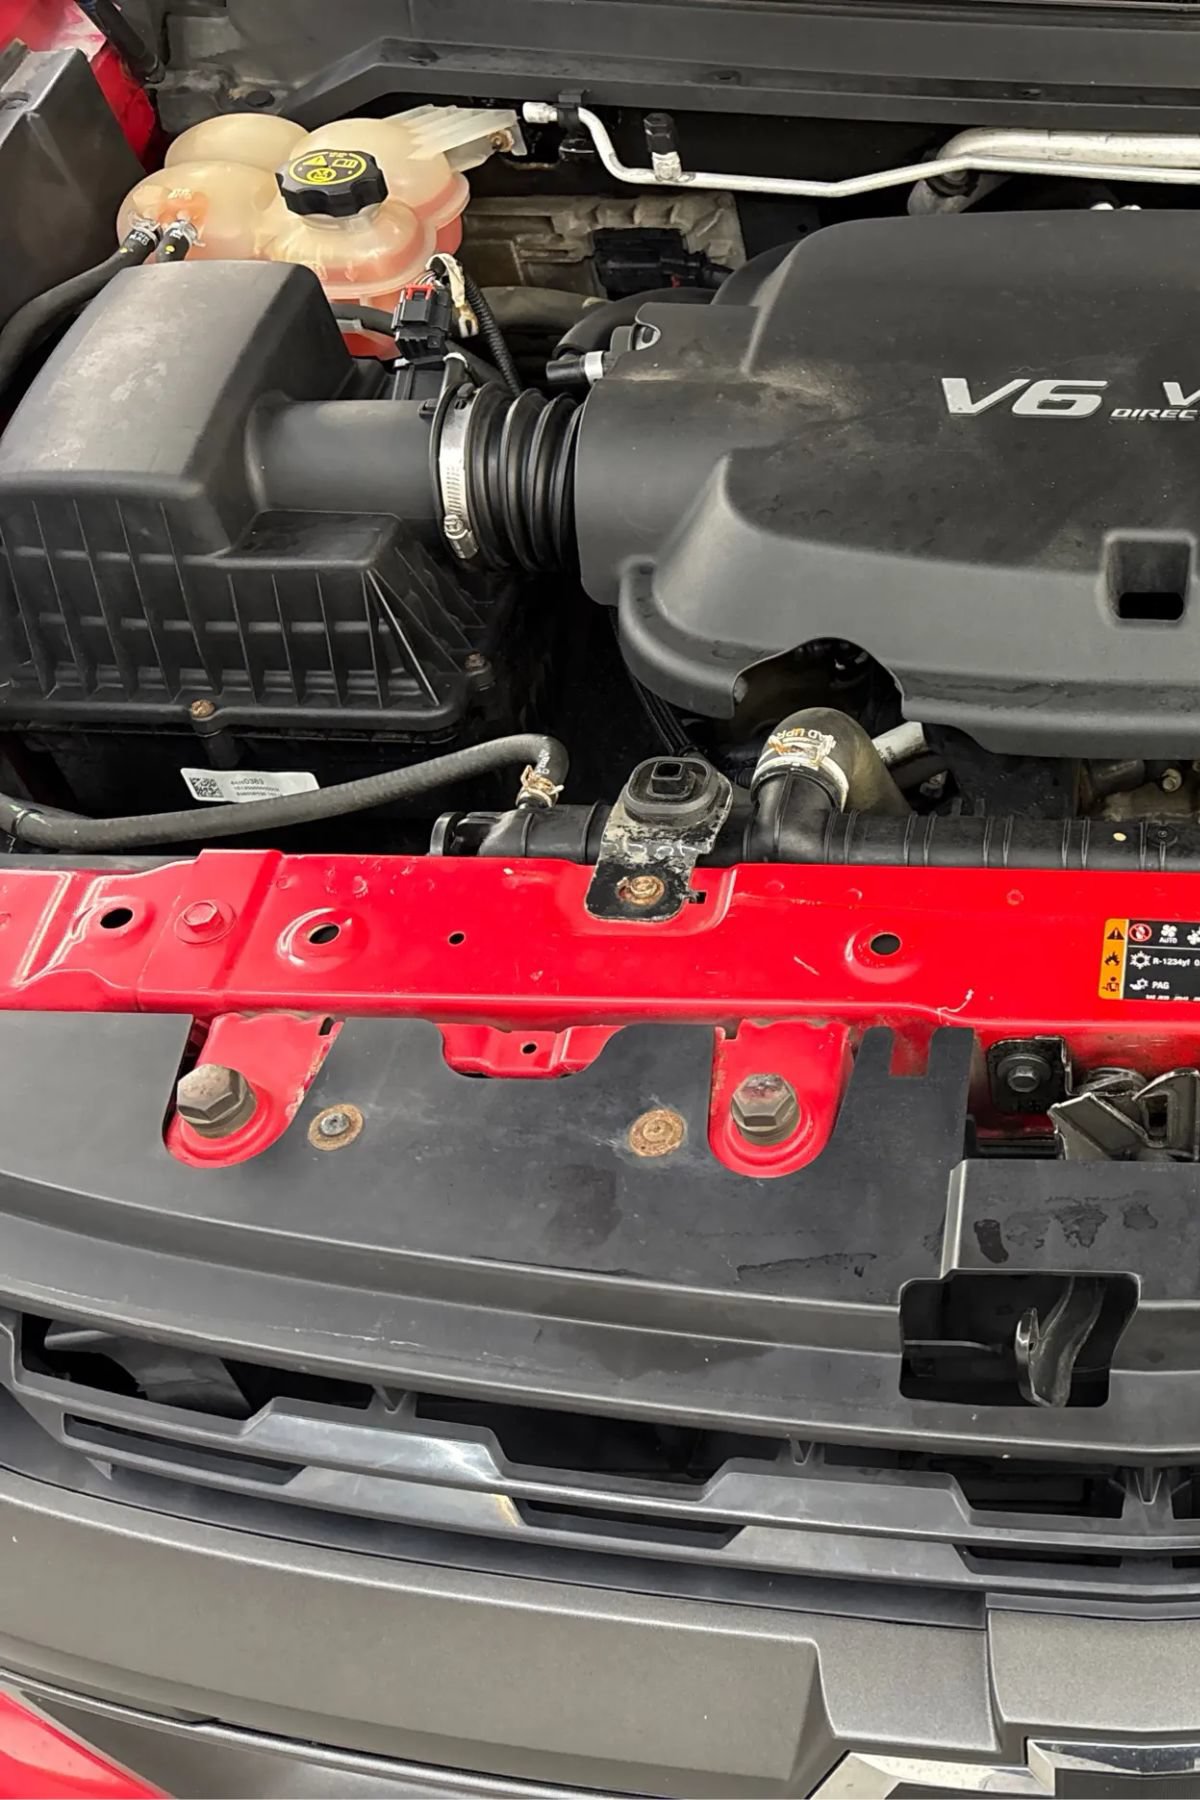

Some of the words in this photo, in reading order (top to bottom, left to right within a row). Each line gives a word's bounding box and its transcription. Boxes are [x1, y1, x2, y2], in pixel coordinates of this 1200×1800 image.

[941, 377, 1107, 418] V6
[1159, 936, 1178, 944] AUTO
[1152, 957, 1191, 967] R-1234yf
[1152, 981, 1170, 990] PAG
